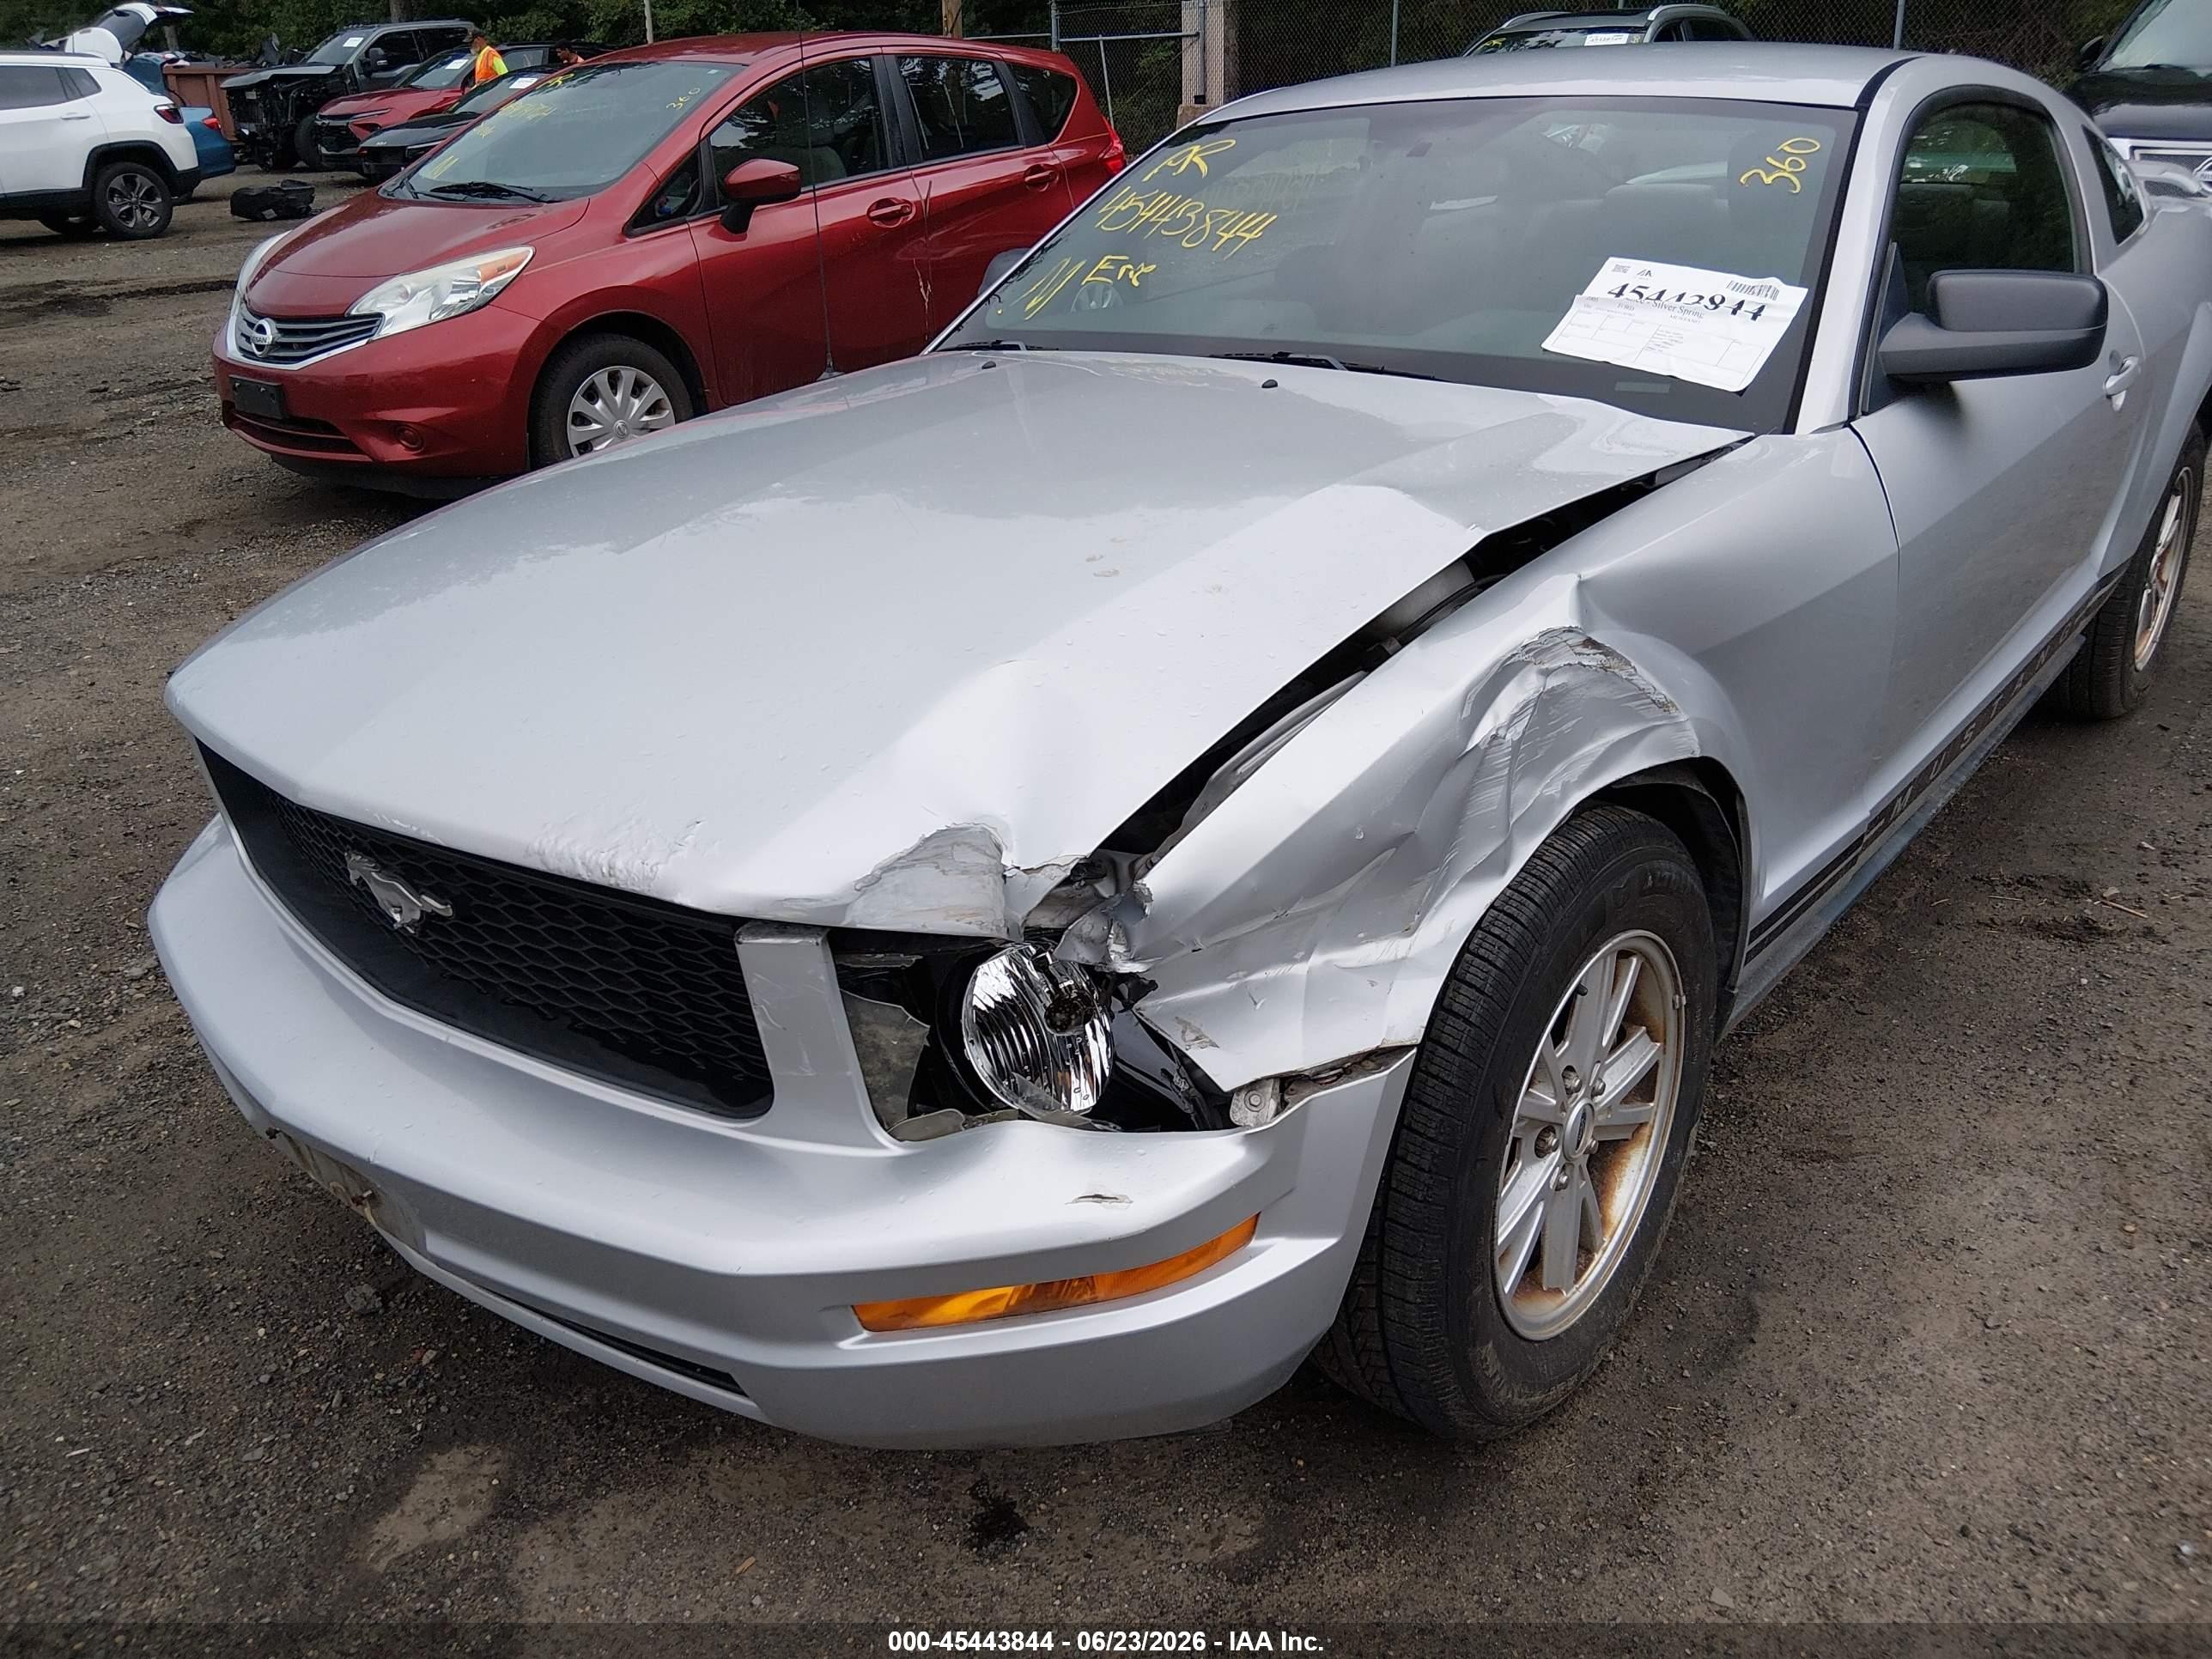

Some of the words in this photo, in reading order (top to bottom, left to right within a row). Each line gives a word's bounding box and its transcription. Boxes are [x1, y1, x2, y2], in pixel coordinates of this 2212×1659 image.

[1739, 137, 1821, 194] 360
[1094, 185, 1278, 261] 45443844
[1651, 299, 1677, 313] Silver
[1677, 306, 1705, 319] Spring
[1890, 623, 2075, 822] MUSTANG
